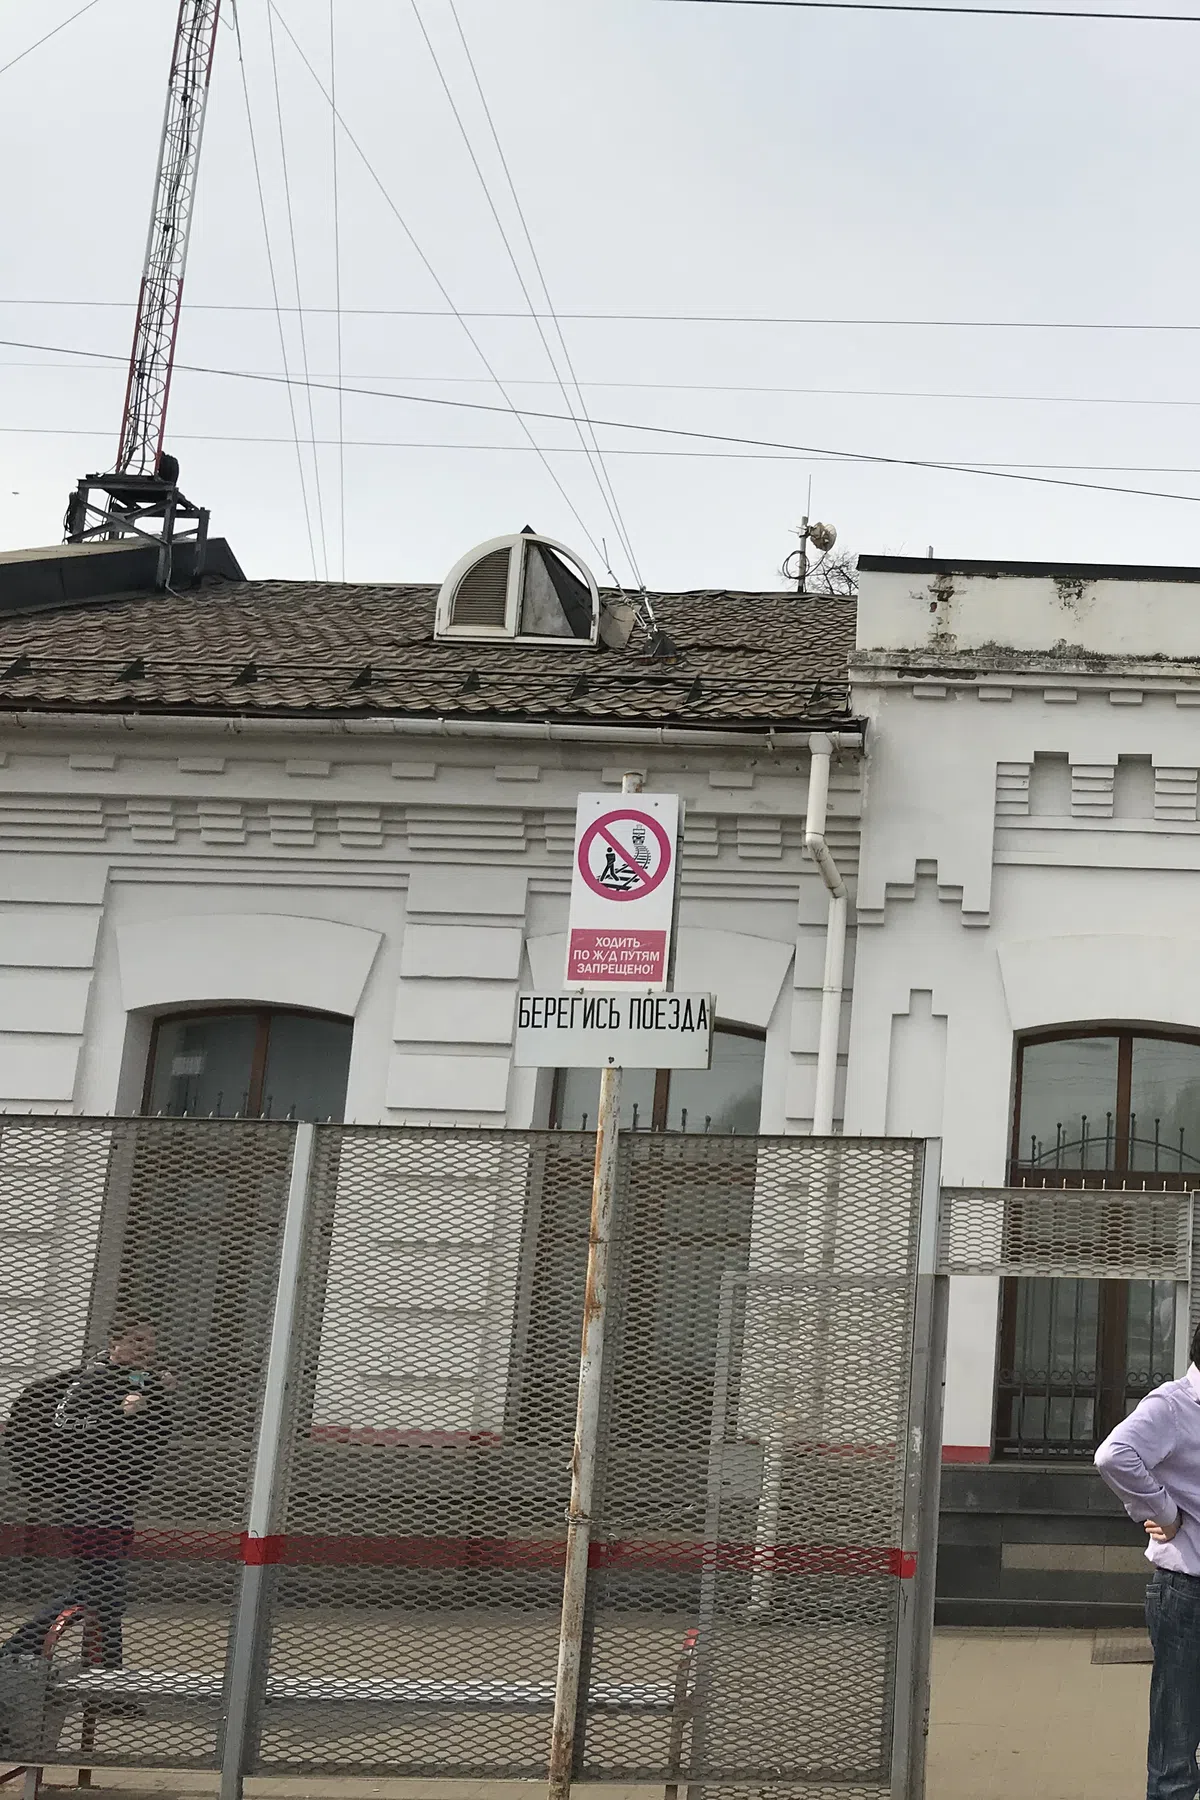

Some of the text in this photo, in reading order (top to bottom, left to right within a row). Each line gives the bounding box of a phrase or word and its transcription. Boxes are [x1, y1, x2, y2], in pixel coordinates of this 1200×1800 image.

[595, 936, 641, 949] ХОДИТЬ
[573, 949, 660, 962] ПО Ж/Д ПУТЯМ
[576, 963, 654, 975] ЗАПРЕЩЕНО!
[518, 997, 708, 1032] БЕРЕГИСЬ ПОЕЗДА
